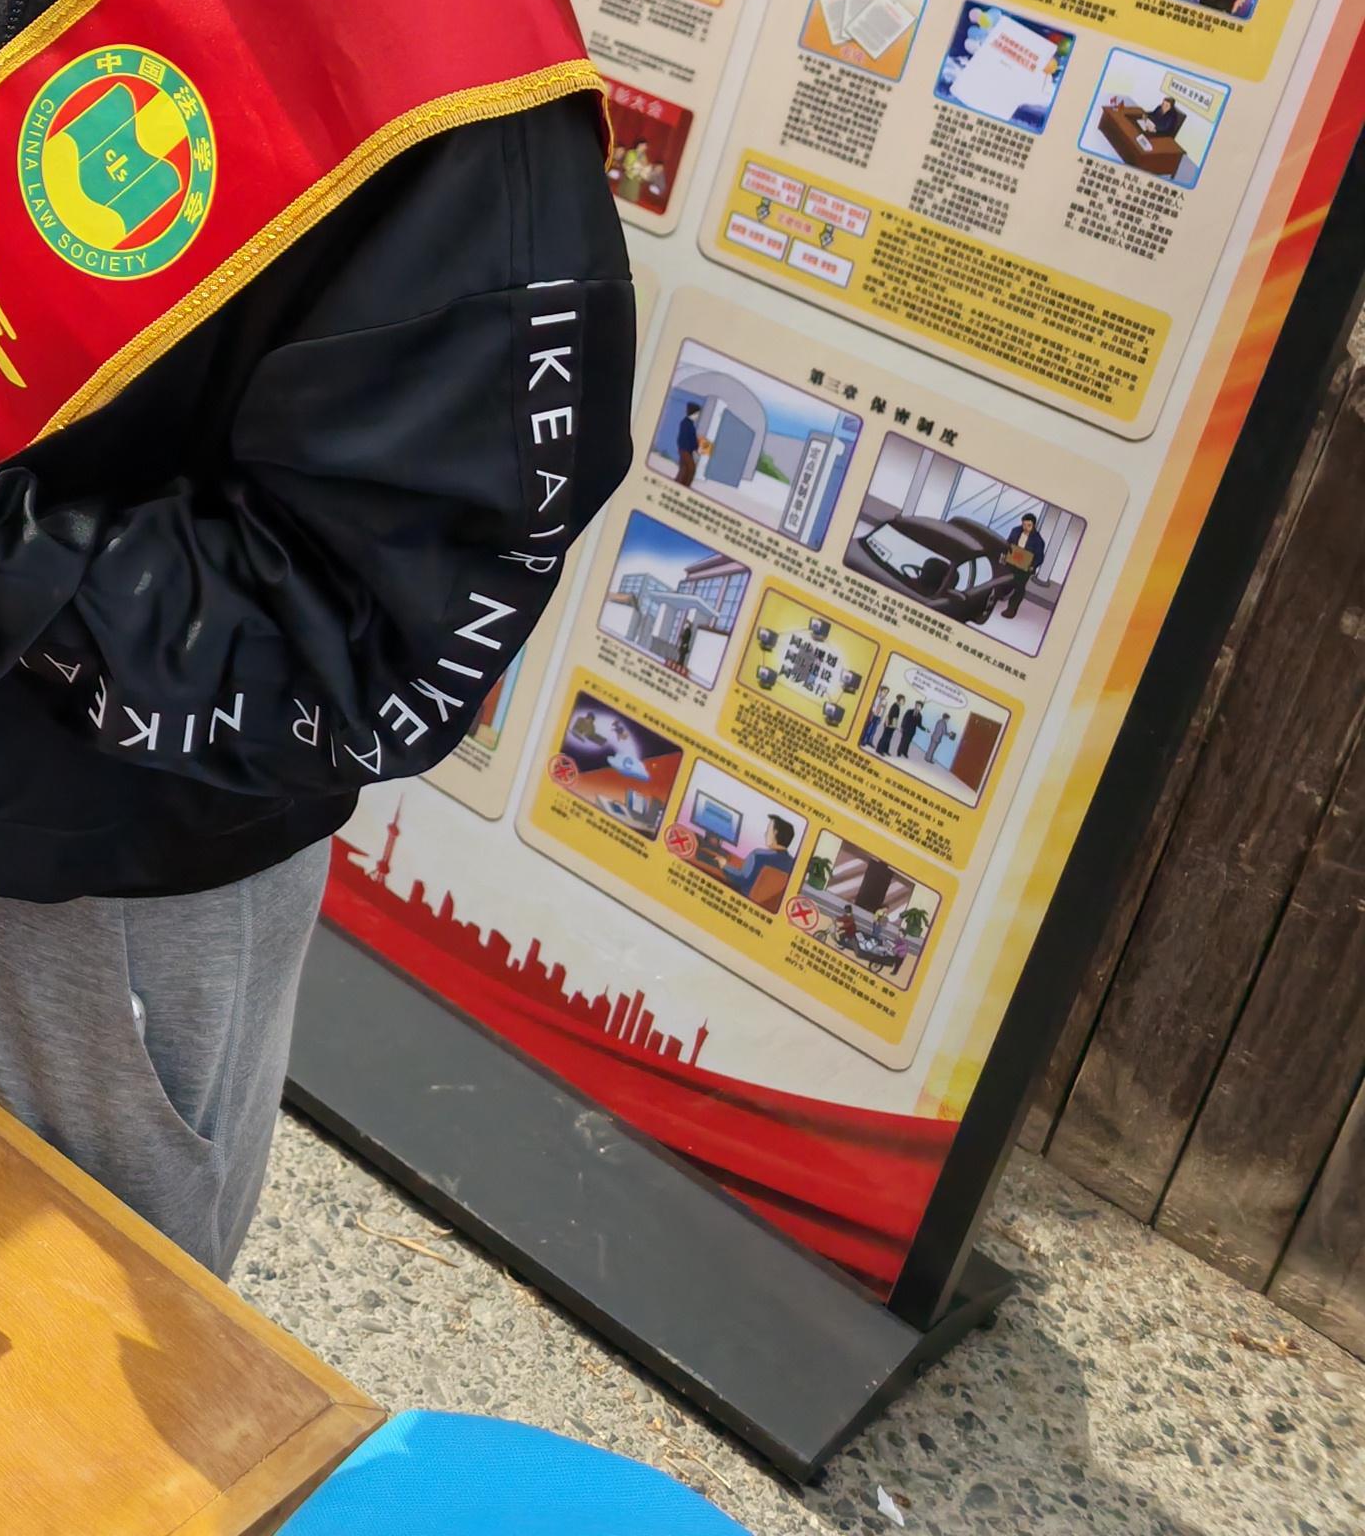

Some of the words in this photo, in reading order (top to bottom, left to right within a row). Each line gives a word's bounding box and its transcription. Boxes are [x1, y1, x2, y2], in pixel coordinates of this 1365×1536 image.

[25, 98, 55, 171] CHINA
[96, 52, 211, 225] 中国法学会
[27, 182, 57, 229] LAW
[57, 233, 148, 272] SOCIETY
[526, 279, 577, 444] IKE
